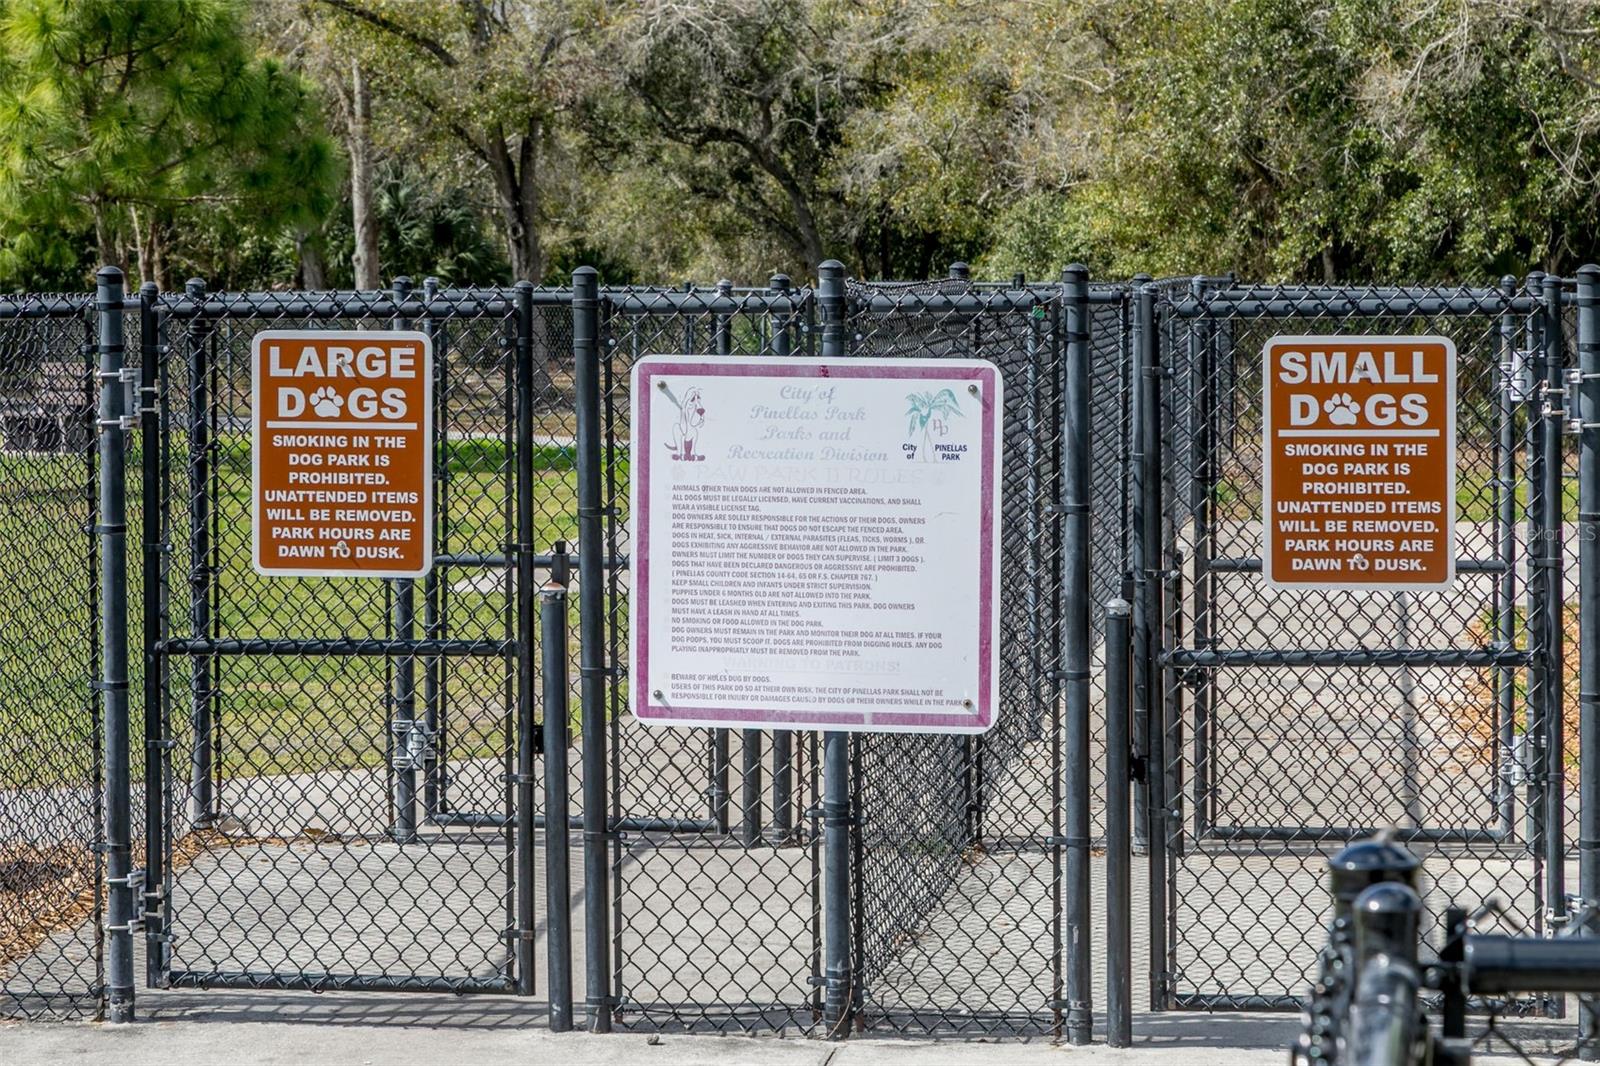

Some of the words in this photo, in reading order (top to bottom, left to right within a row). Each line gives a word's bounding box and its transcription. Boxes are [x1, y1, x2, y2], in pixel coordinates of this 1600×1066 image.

[270, 346, 416, 378] LARGE
[1279, 352, 1438, 383] SMALL
[780, 386, 810, 401] City
[818, 387, 836, 402] of
[278, 386, 407, 419] DGS
[750, 407, 818, 421] Pinellas
[824, 407, 866, 421] Park
[1290, 393, 1429, 426] DGS
[761, 427, 813, 441] Parks
[819, 427, 851, 441] and
[273, 435, 348, 448] SMOKING
[353, 436, 369, 447] IN
[375, 436, 405, 448] THE
[727, 446, 814, 460] Recreation
[820, 446, 888, 462] Division
[903, 444, 917, 453] City
[935, 444, 967, 452] PINELLAS
[1285, 444, 1365, 456] SMOKING
[1371, 445, 1388, 456] IN
[1393, 445, 1428, 456] THE
[289, 454, 322, 466] DOG
[328, 455, 370, 466] PARK
[375, 455, 390, 466] IS
[1303, 464, 1338, 475] DOG
[1344, 464, 1389, 475] PARK
[1395, 464, 1410, 475] IS
[289, 473, 389, 484] PROHIBITED.
[1303, 483, 1410, 494] PROHIBITED.
[265, 491, 367, 503] UNATTENDED
[372, 492, 418, 503] ITEMS
[1277, 502, 1386, 513] UNATTENDED
[1392, 502, 1441, 513] ITEMS
[267, 509, 304, 520] WILL
[310, 510, 330, 521] BE
[336, 510, 415, 522] REMOVED.
[1279, 521, 1320, 532] WILL
[1325, 521, 1347, 532] BE
[1353, 521, 1439, 532] REMOVED.
[272, 527, 314, 539] PARK
[319, 528, 374, 540] HOURS
[380, 529, 410, 540] ARE
[1285, 540, 1329, 551] PARK
[1336, 540, 1394, 551] HOURS
[1400, 540, 1433, 551] ARE
[279, 546, 324, 557] DAWN
[330, 547, 350, 558] TO
[356, 547, 404, 559] DUSK.
[1292, 559, 1341, 570] DAWN
[1347, 559, 1369, 570] TO
[1375, 559, 1426, 571] DUSK.
